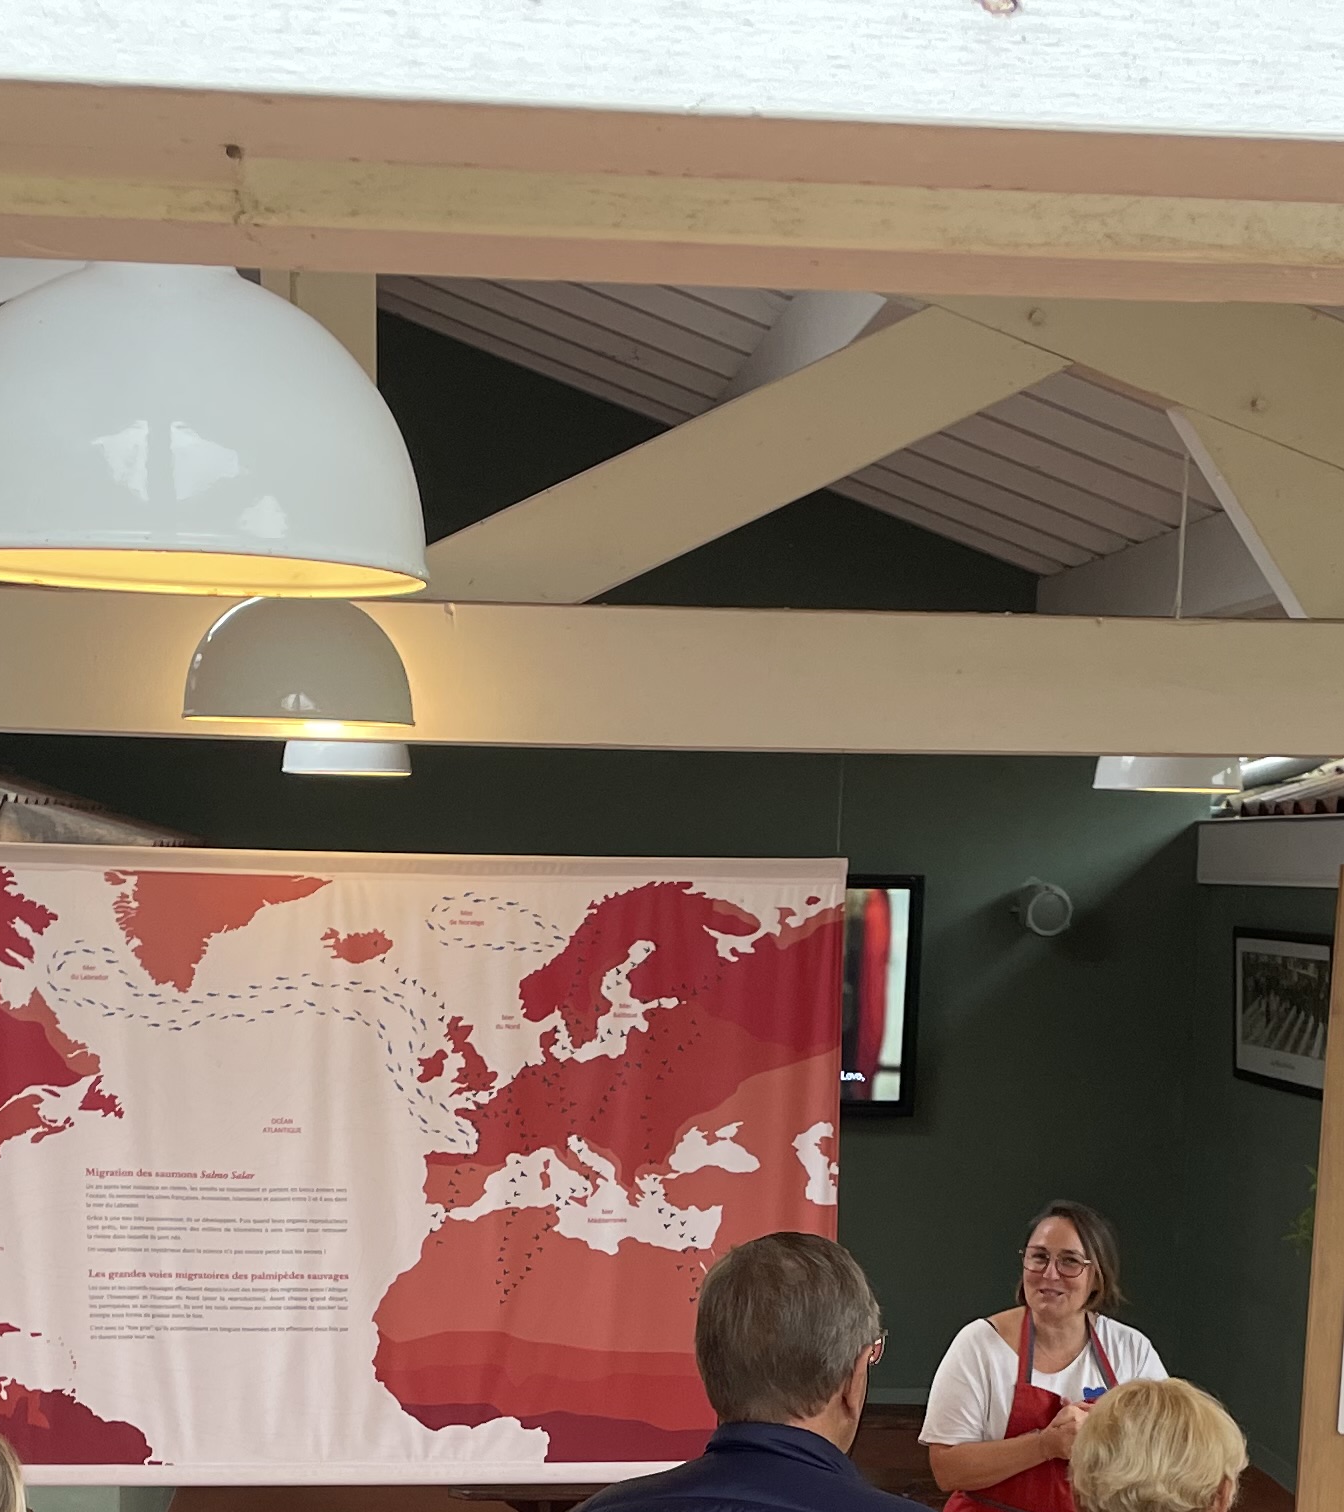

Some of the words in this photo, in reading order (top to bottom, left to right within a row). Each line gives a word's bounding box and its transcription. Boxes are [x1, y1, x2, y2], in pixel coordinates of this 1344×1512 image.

[85, 1168, 134, 1180] Migration
[136, 1168, 152, 1178] des
[155, 1171, 198, 1179] saumons
[200, 1170, 228, 1180] Salmo
[231, 1170, 256, 1180] Salar
[88, 1269, 106, 1278] Les
[108, 1268, 146, 1282] grandes
[149, 1269, 172, 1280] voies
[175, 1270, 230, 1282] migratoires
[232, 1270, 248, 1280] des
[251, 1270, 305, 1283] palmipèdes
[307, 1272, 349, 1282] sauvages
